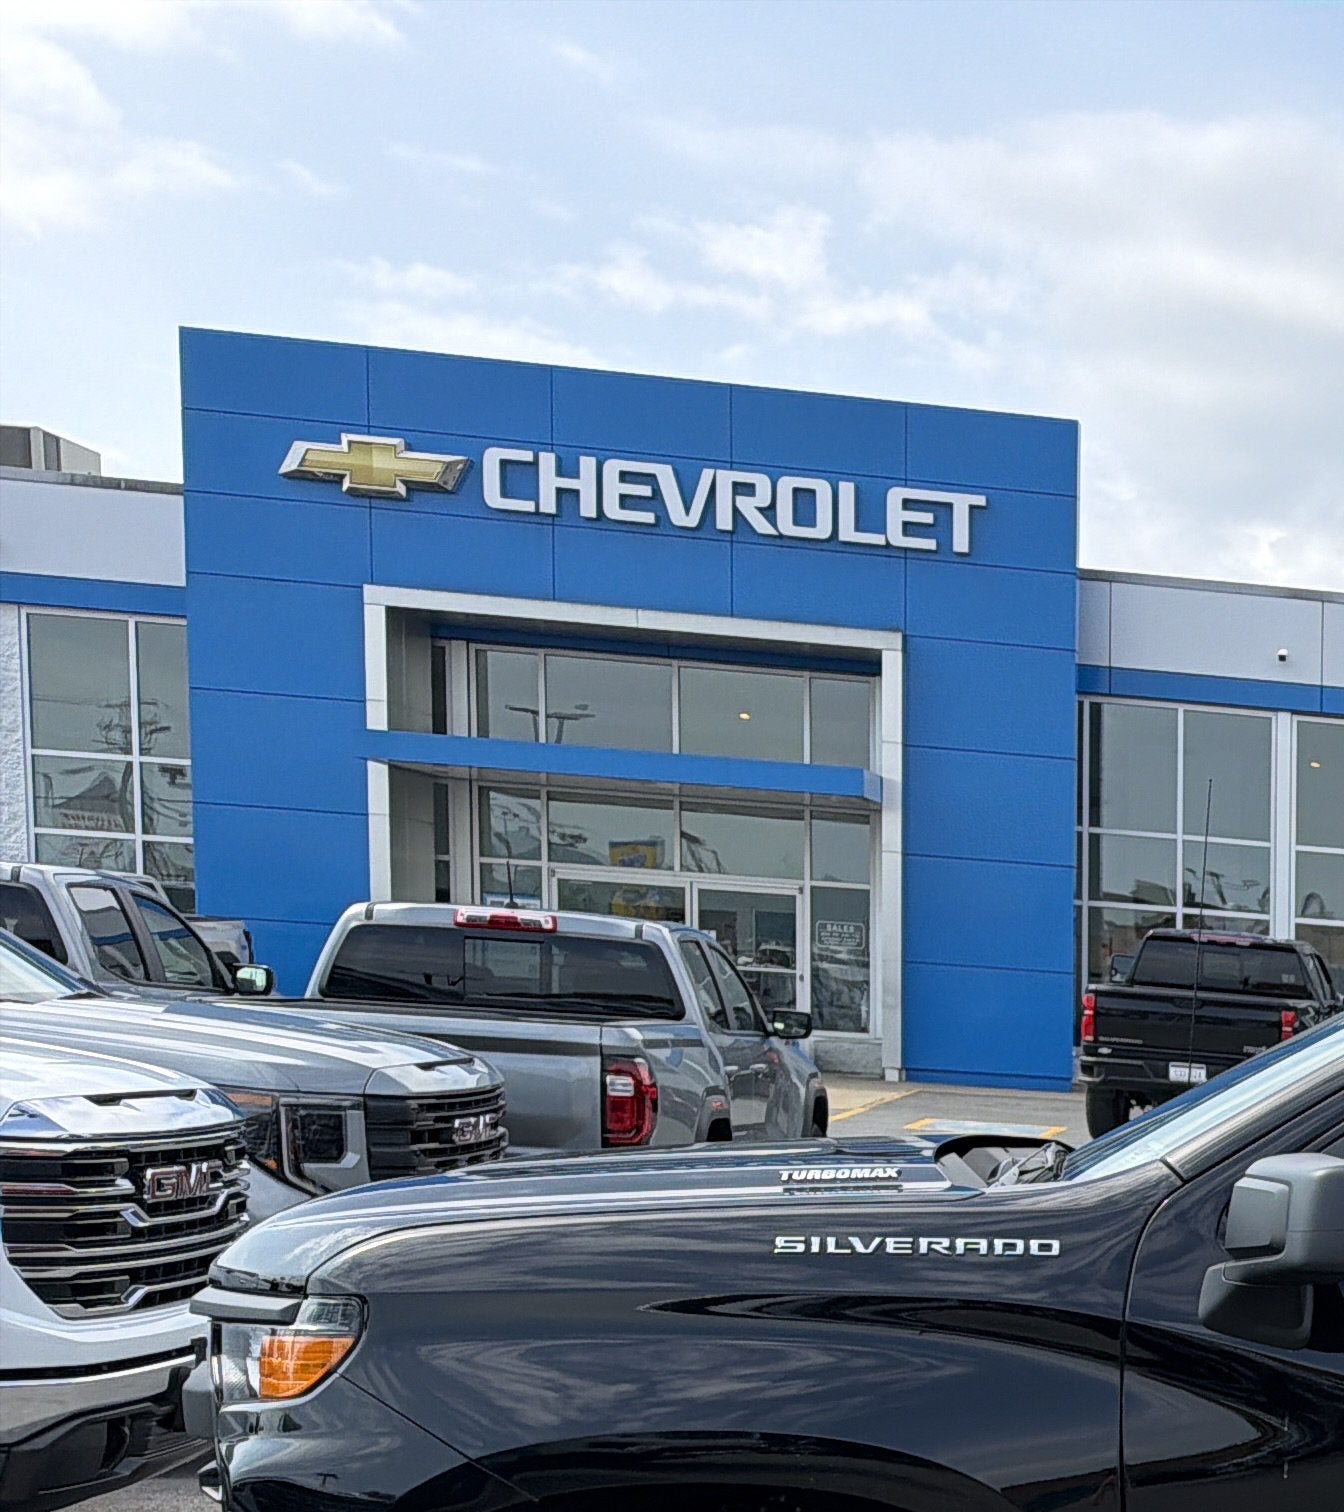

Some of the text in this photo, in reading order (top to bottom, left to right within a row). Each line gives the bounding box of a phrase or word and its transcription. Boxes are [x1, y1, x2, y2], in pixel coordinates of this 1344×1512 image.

[483, 446, 988, 555] CHEVROLET
[143, 1159, 225, 1202] GMC
[778, 1167, 902, 1182] TURBOMAX
[773, 1235, 1061, 1257] SILVERADO
